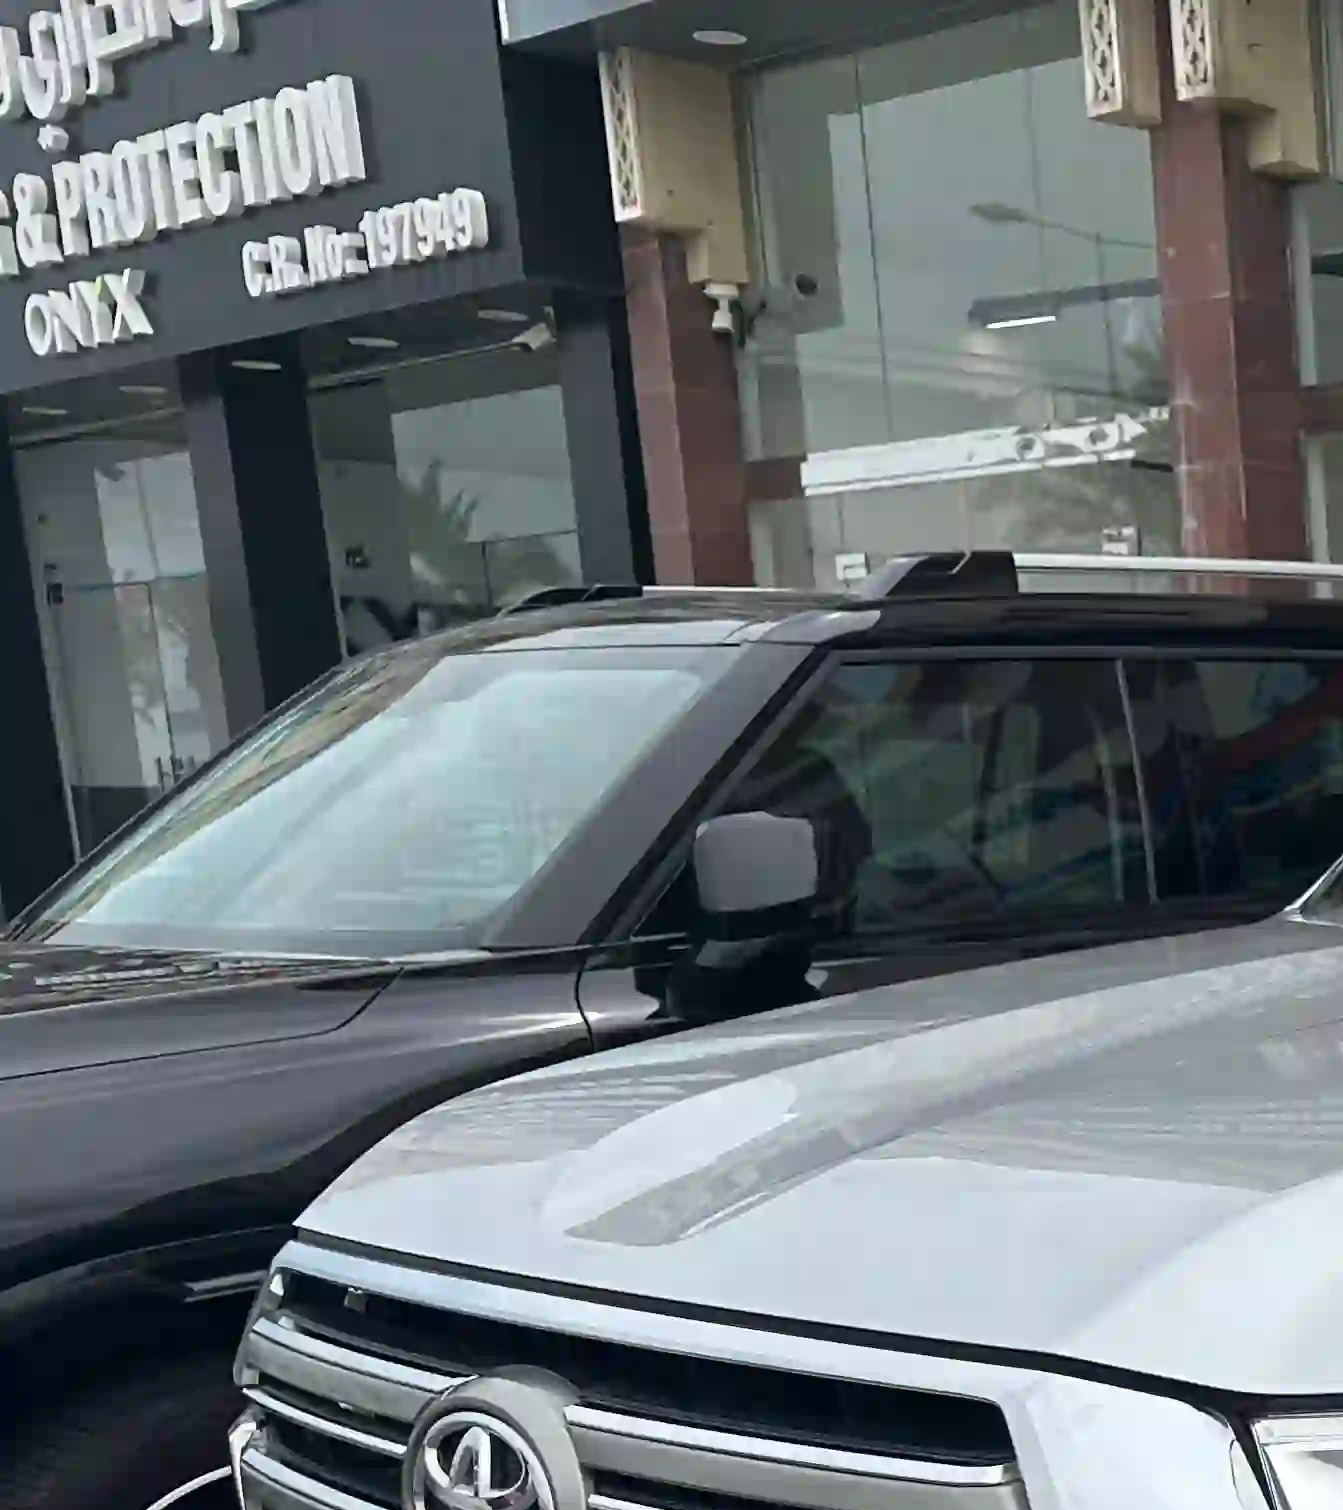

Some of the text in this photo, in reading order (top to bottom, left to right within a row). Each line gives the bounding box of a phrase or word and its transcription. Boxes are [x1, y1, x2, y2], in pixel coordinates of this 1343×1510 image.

[13, 172, 64, 268] &
[52, 74, 366, 257] PROTECTION
[24, 267, 154, 357] ONYX
